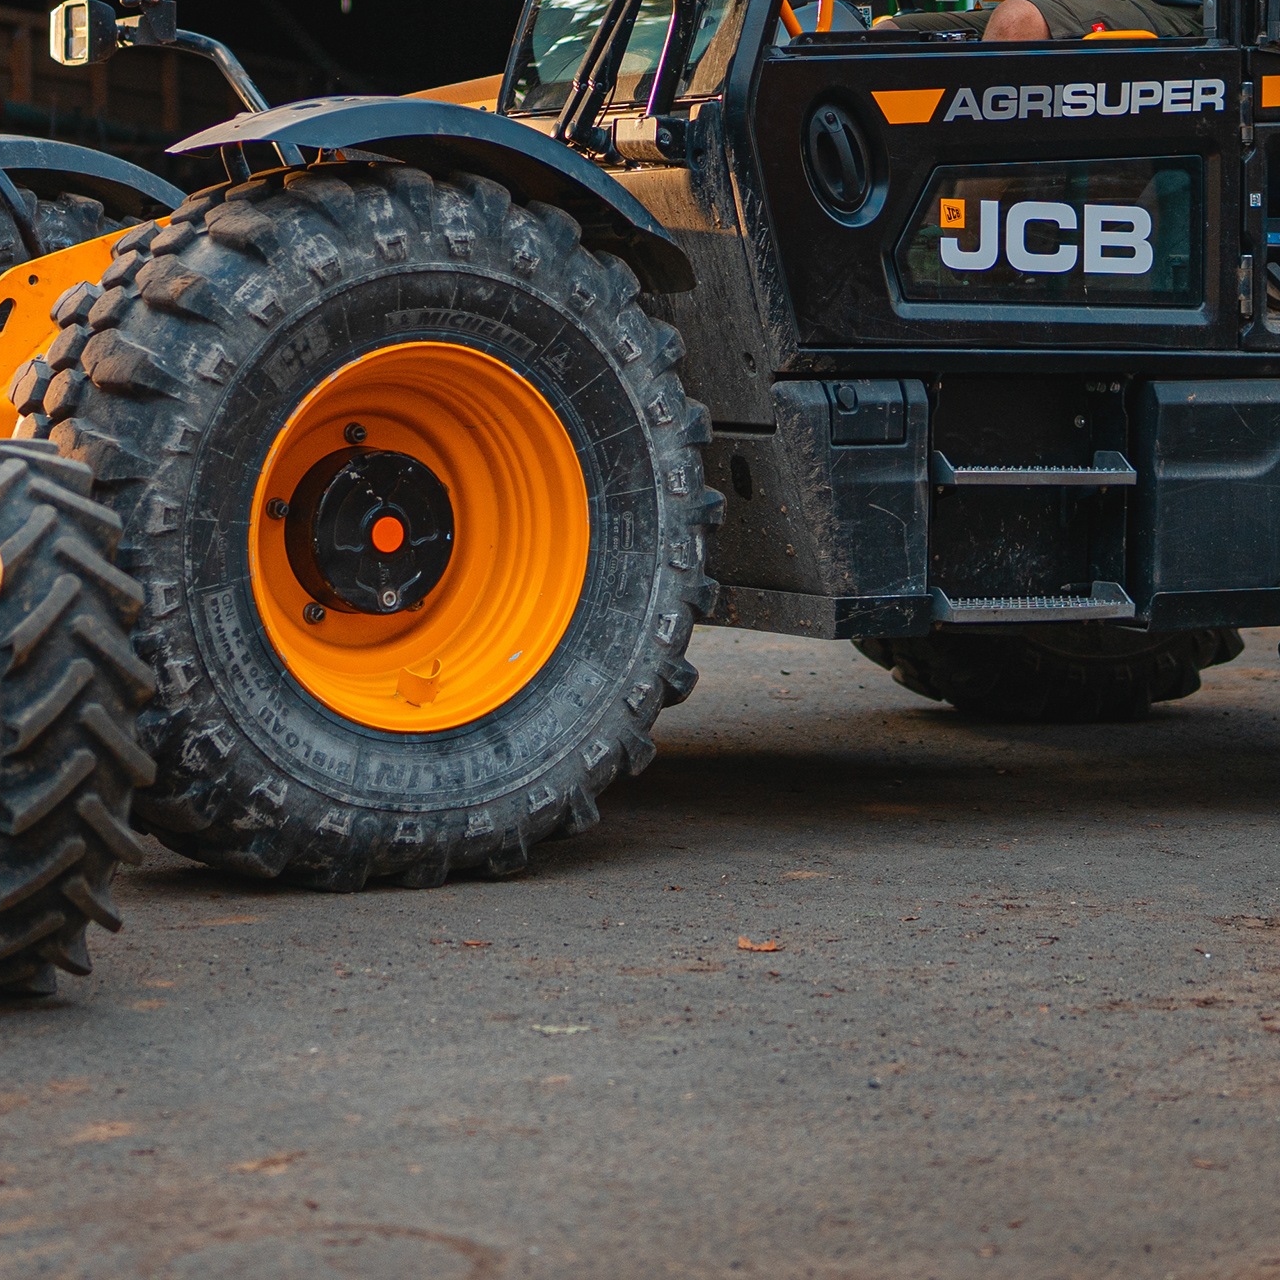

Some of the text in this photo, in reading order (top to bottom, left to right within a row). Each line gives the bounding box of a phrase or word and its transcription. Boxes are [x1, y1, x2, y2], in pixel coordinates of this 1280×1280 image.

[943, 78, 1226, 122] AGRISUPER
[947, 206, 961, 220] JCB
[940, 199, 1154, 275] JCB
[420, 311, 533, 360] MICHELIN
[209, 596, 236, 662] SURFACE
[230, 626, 246, 650] 24
[239, 650, 253, 666] R
[228, 662, 257, 701] HARD
[257, 705, 351, 776] BIBLOAD
[370, 707, 563, 790] MICHELIN
